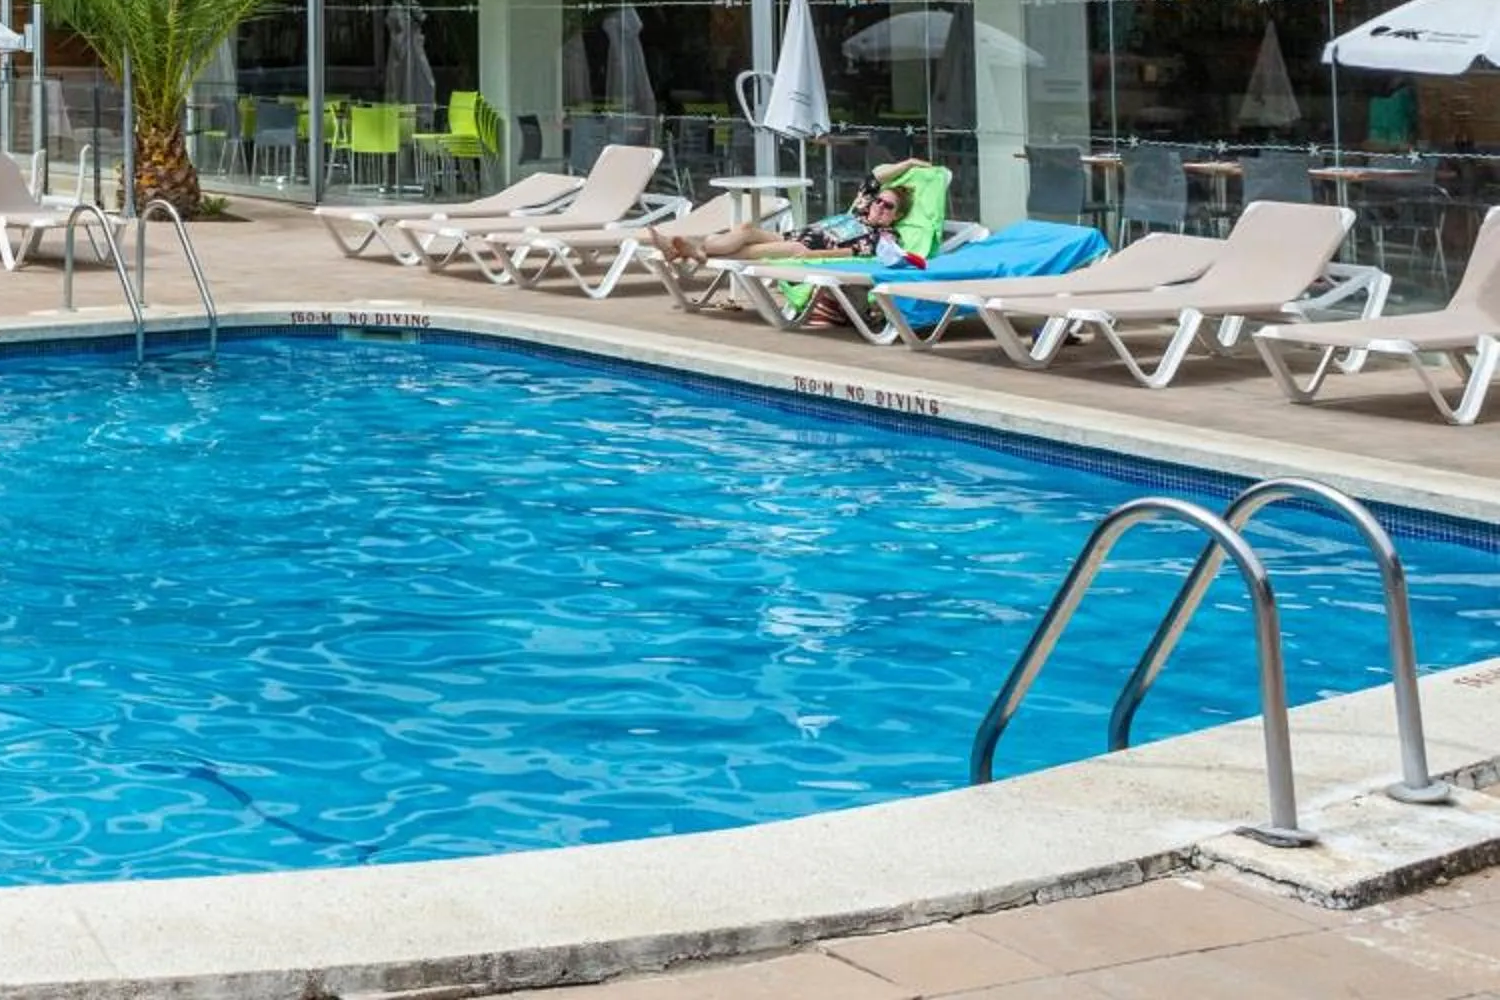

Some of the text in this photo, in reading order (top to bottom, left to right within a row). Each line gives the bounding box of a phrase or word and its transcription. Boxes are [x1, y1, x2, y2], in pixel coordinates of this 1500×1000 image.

[348, 311, 367, 325] NO
[375, 312, 431, 328] DIVING
[846, 384, 865, 401] NO
[875, 389, 940, 415] DIVING
